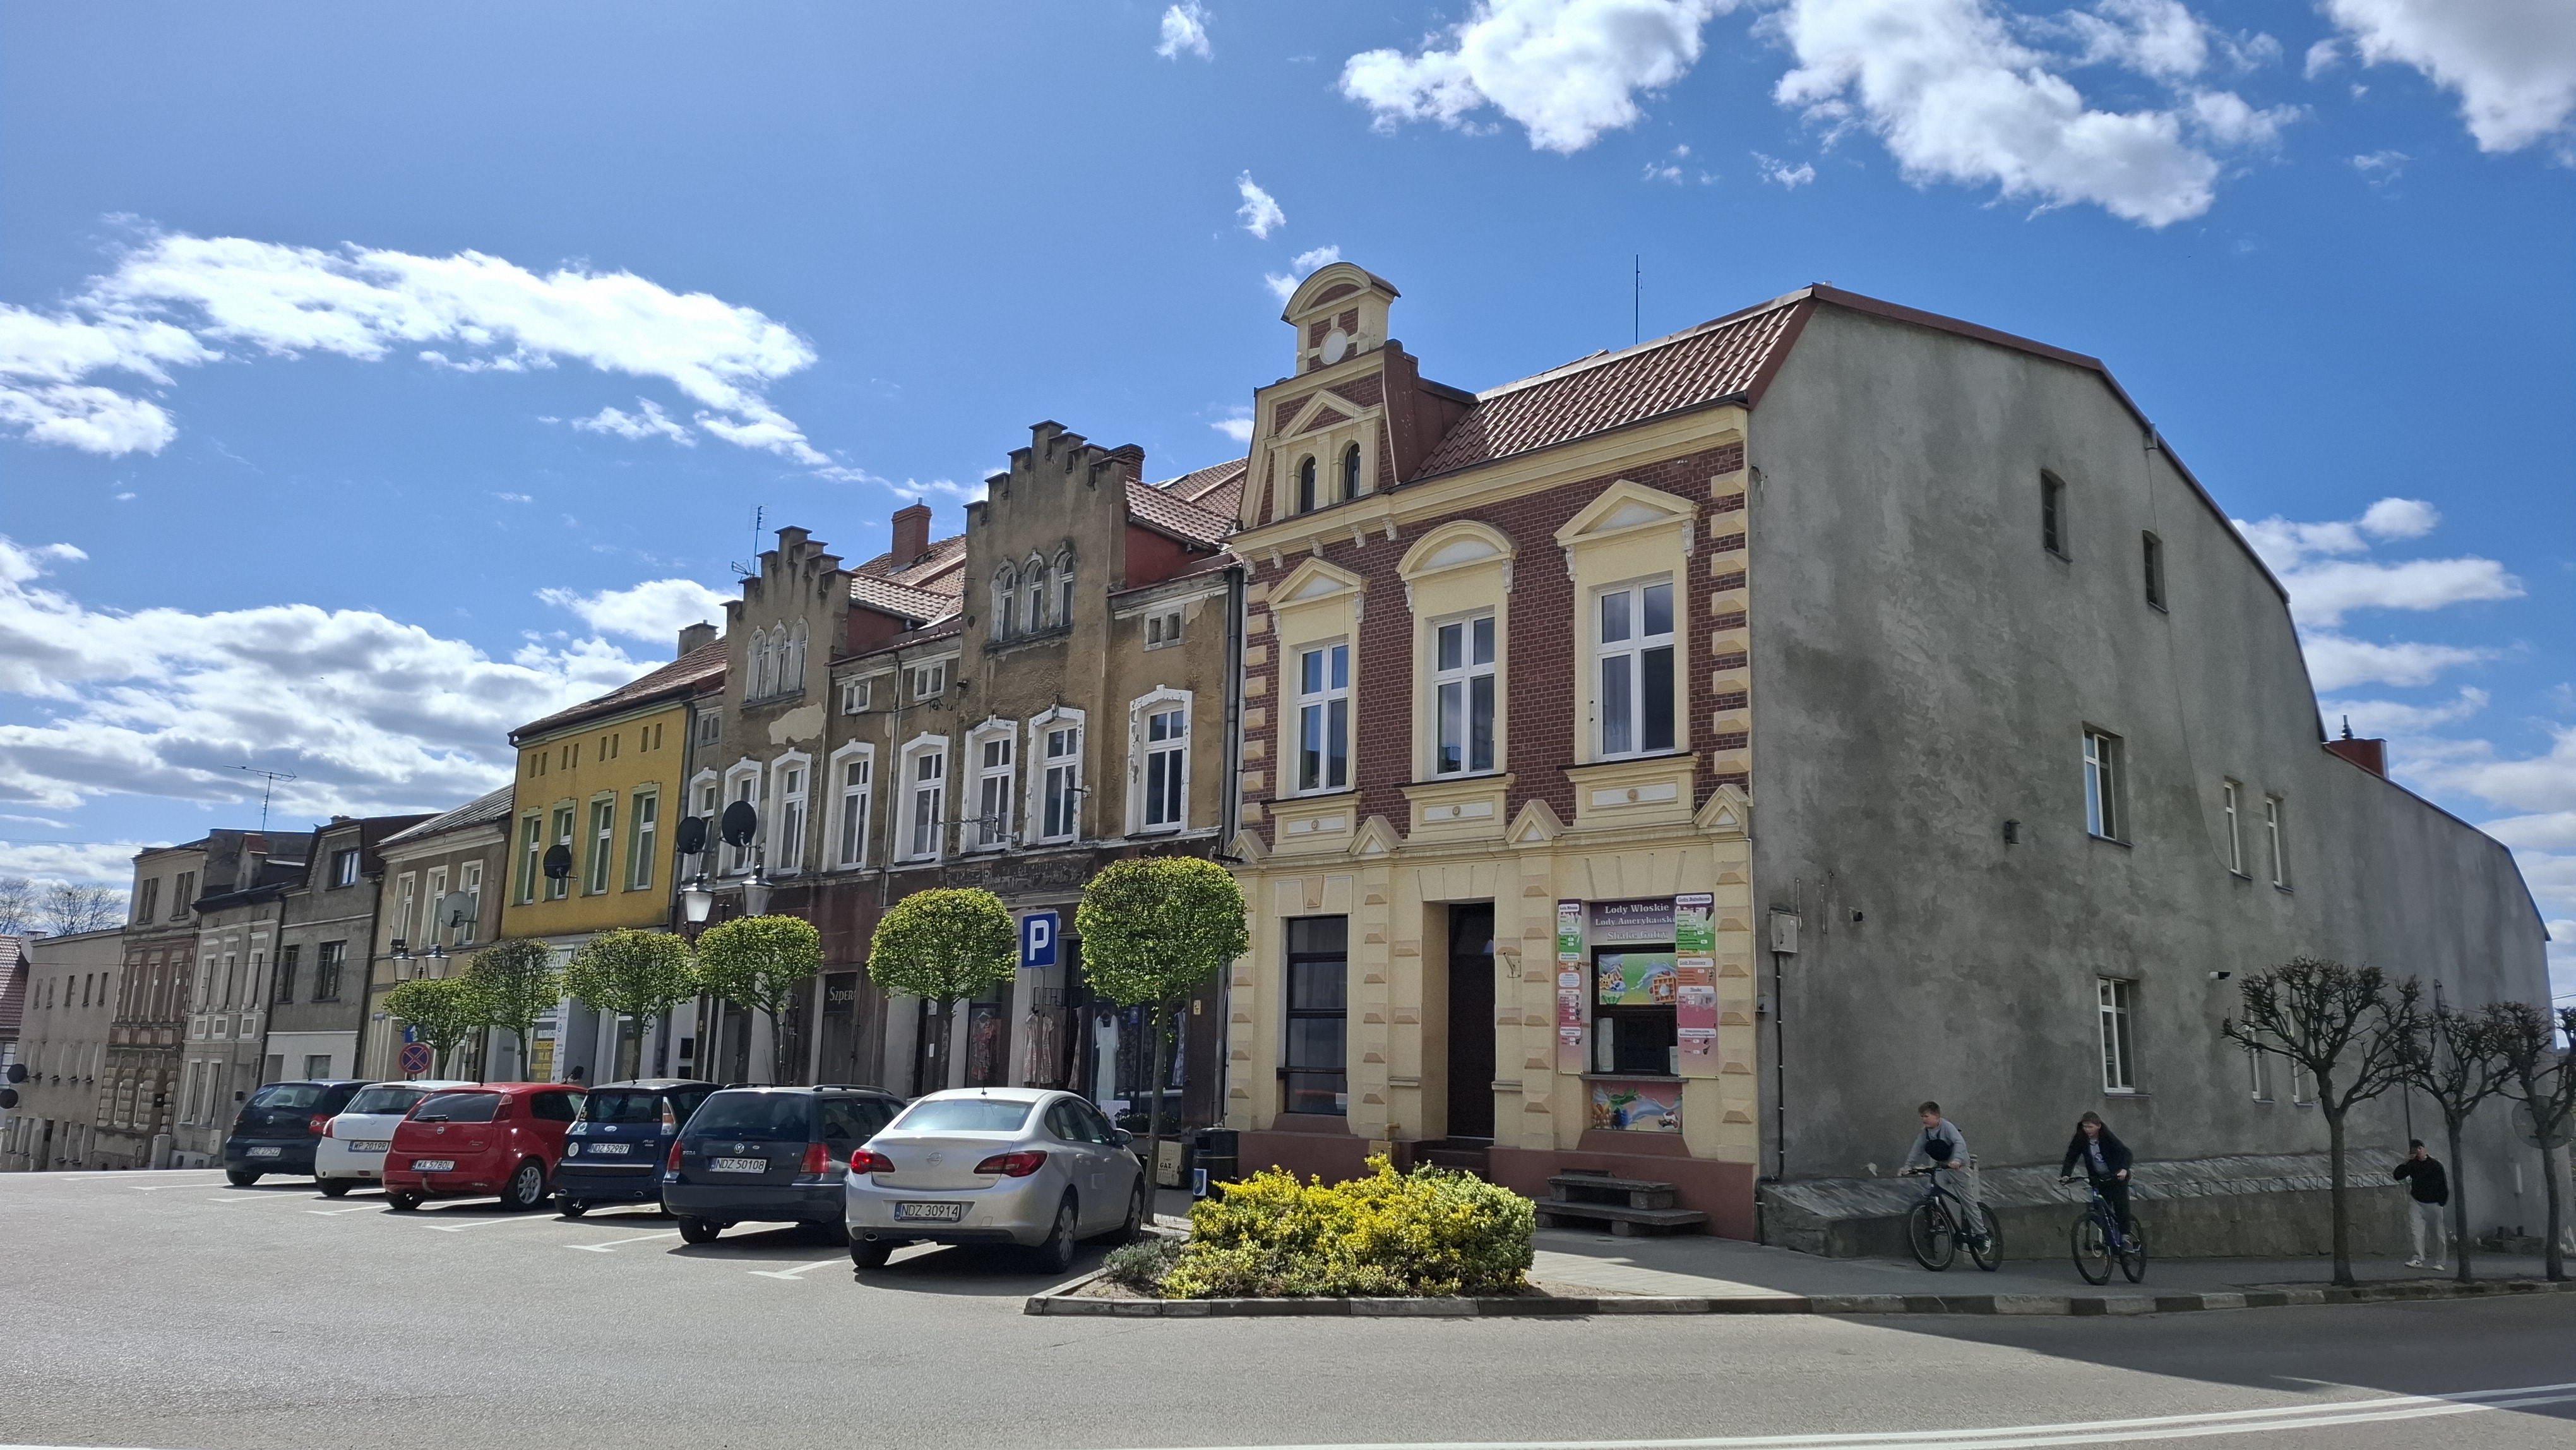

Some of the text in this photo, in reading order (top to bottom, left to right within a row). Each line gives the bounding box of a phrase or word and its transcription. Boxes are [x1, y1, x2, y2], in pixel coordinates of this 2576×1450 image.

[1604, 905, 1628, 914] Lody
[1595, 918, 1616, 927] Lody
[1607, 931, 1637, 940] Shake
[1029, 920, 1049, 961] P
[592, 1144, 628, 1153] NDZ 52987
[429, 1161, 451, 1169] 5780L
[715, 1159, 765, 1170] NDZ 50108
[902, 1204, 958, 1217] NDZ 30914
